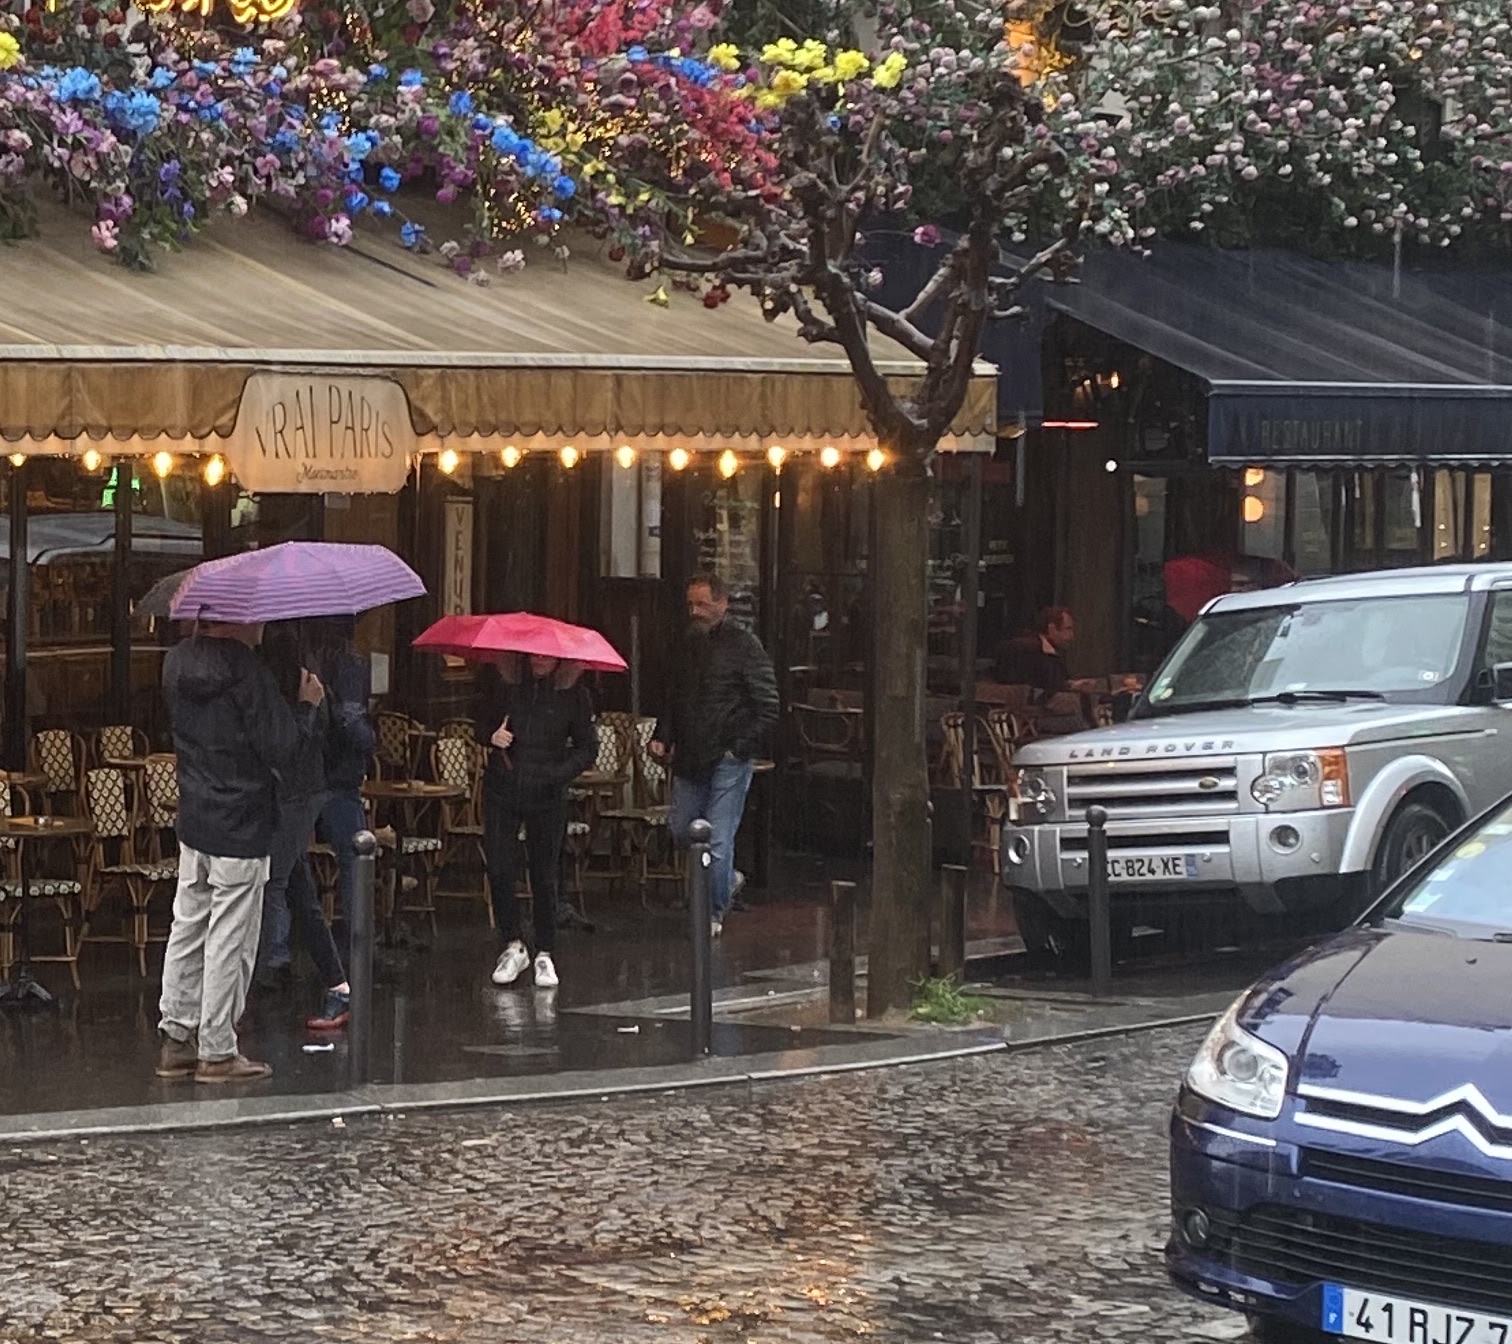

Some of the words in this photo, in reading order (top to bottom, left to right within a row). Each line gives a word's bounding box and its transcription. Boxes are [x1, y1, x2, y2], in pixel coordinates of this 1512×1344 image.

[255, 384, 318, 459] VRAI
[328, 384, 394, 459] PARIS
[1068, 746, 1131, 759] LAND
[1145, 740, 1235, 755] ROVER
[1355, 1296, 1394, 1339] 41
